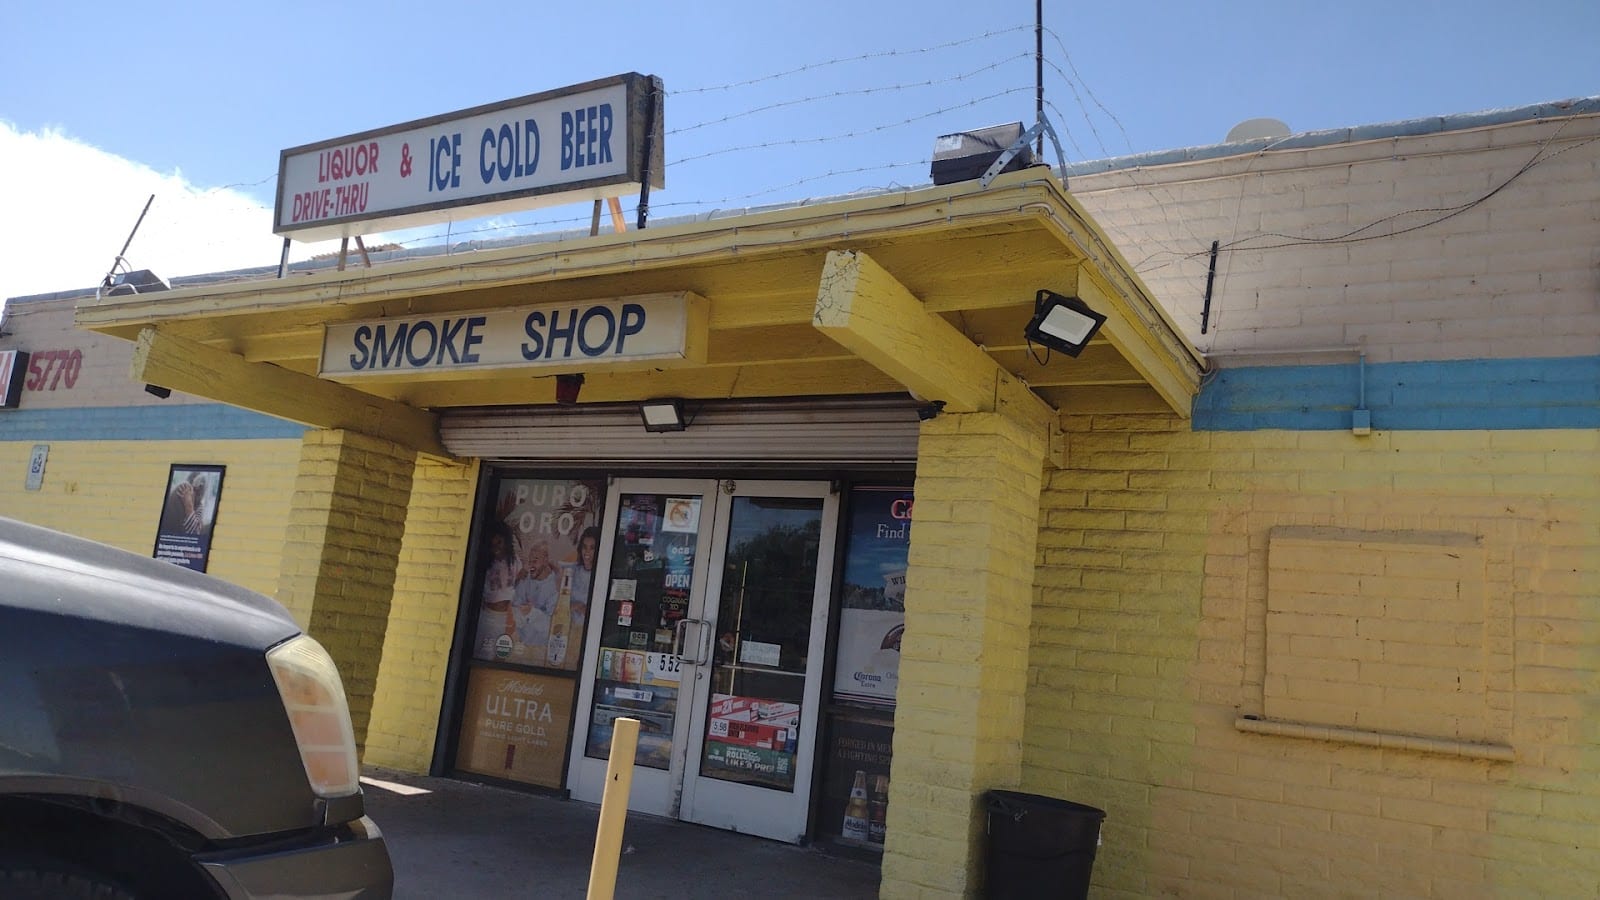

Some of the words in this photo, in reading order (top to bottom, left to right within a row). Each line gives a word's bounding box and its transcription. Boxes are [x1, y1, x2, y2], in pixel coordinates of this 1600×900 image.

[428, 133, 462, 192] ICE
[480, 118, 540, 185] COLD
[561, 103, 614, 171] BEER
[318, 142, 379, 183] LIQUOR
[400, 142, 413, 178] &
[291, 182, 369, 223] DRIVE-THRU
[350, 316, 487, 371] SMOKE
[521, 303, 646, 361] SHOP
[27, 349, 82, 391] 5770
[516, 484, 587, 507] PURO
[519, 511, 575, 535] ORO
[876, 523, 906, 539] Find
[672, 547, 690, 555] OCB
[665, 574, 690, 588] OPEN
[660, 655, 681, 672] 5.52
[496, 678, 544, 697] Michelob
[854, 671, 881, 682] Corona
[486, 694, 553, 723] ULTRA
[485, 718, 513, 731] PURE
